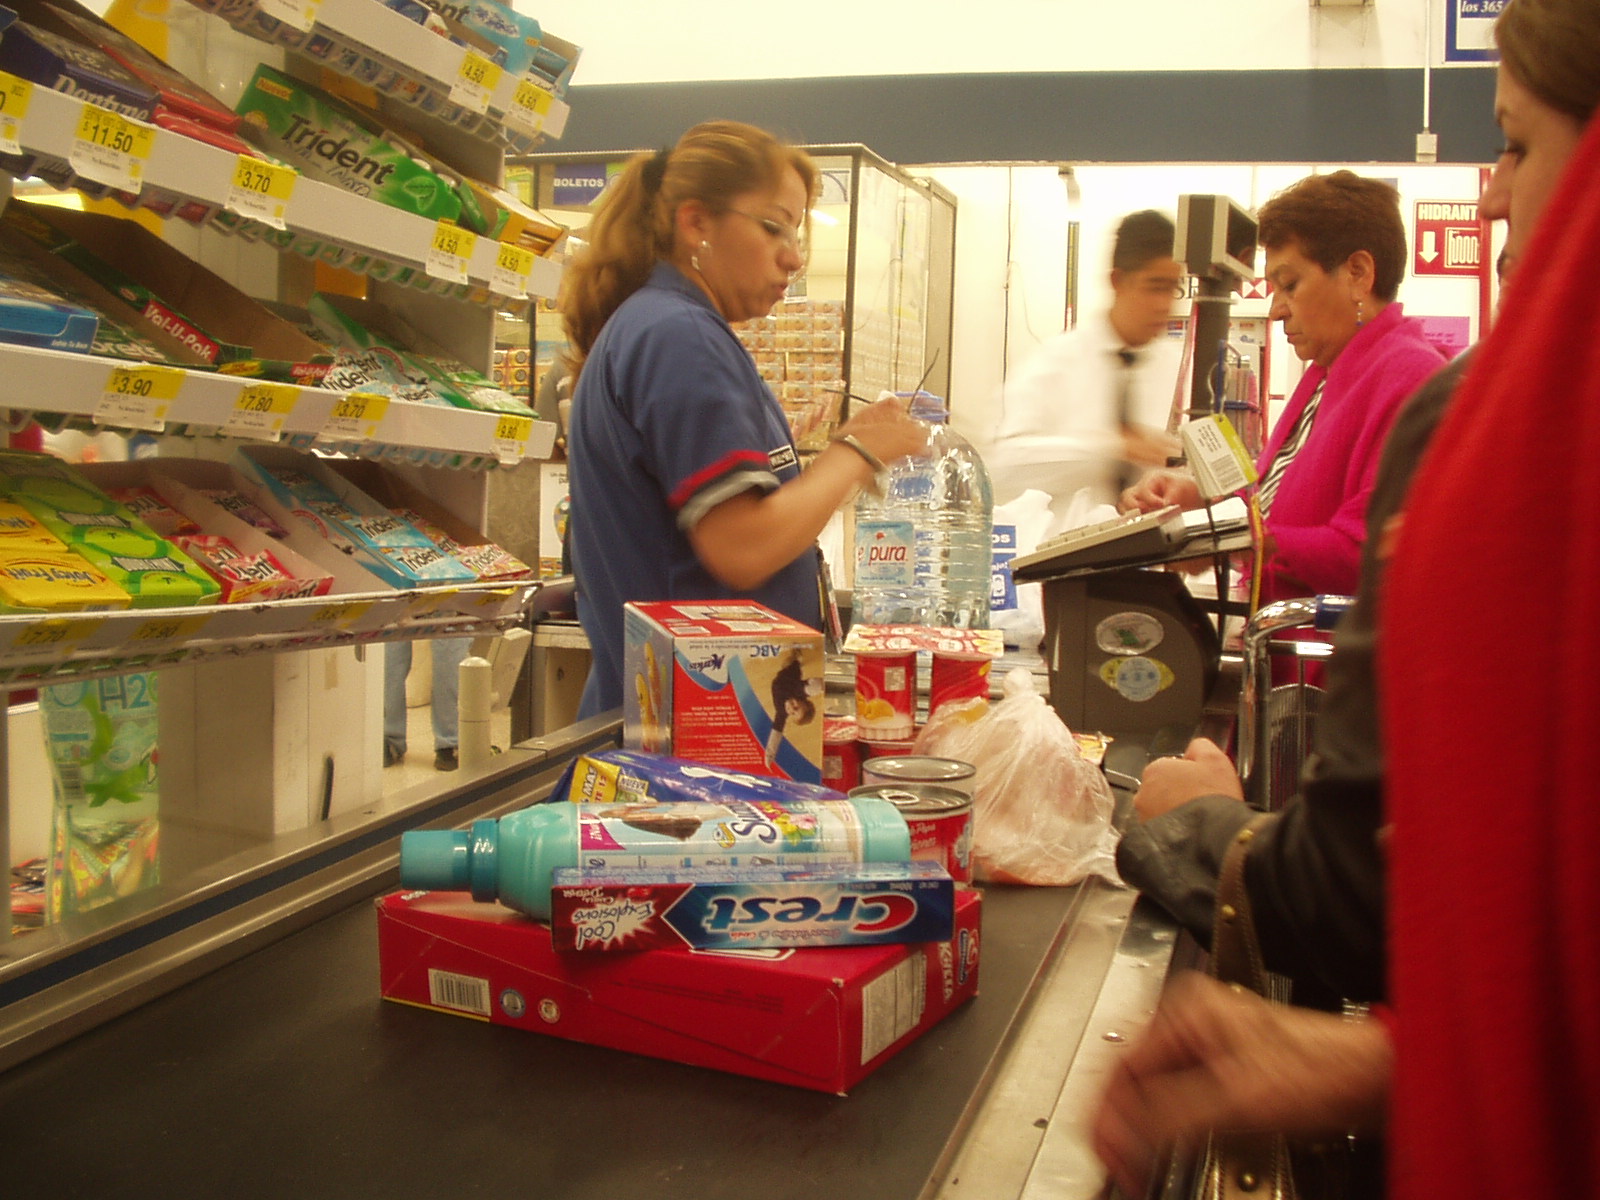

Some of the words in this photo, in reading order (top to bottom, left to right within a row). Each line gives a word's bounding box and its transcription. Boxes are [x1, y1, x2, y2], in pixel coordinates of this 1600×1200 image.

[1462, 0, 1479, 13] los
[1480, 0, 1503, 13] 365
[91, 123, 134, 153] 11.50
[281, 113, 397, 186] Trident
[242, 170, 271, 193] 3.70
[553, 178, 604, 187] BOLETOS
[1417, 203, 1478, 221] HIDRANT
[143, 303, 213, 360] Val-U-Pak
[117, 377, 153, 397] 3.90
[244, 395, 273, 413] 7.80
[397, 548, 444, 572] Trident
[868, 545, 908, 566] pura
[750, 644, 781, 658] ABC
[573, 899, 654, 923] Explosions
[703, 892, 917, 934] Crest
[576, 920, 616, 949] Cool
